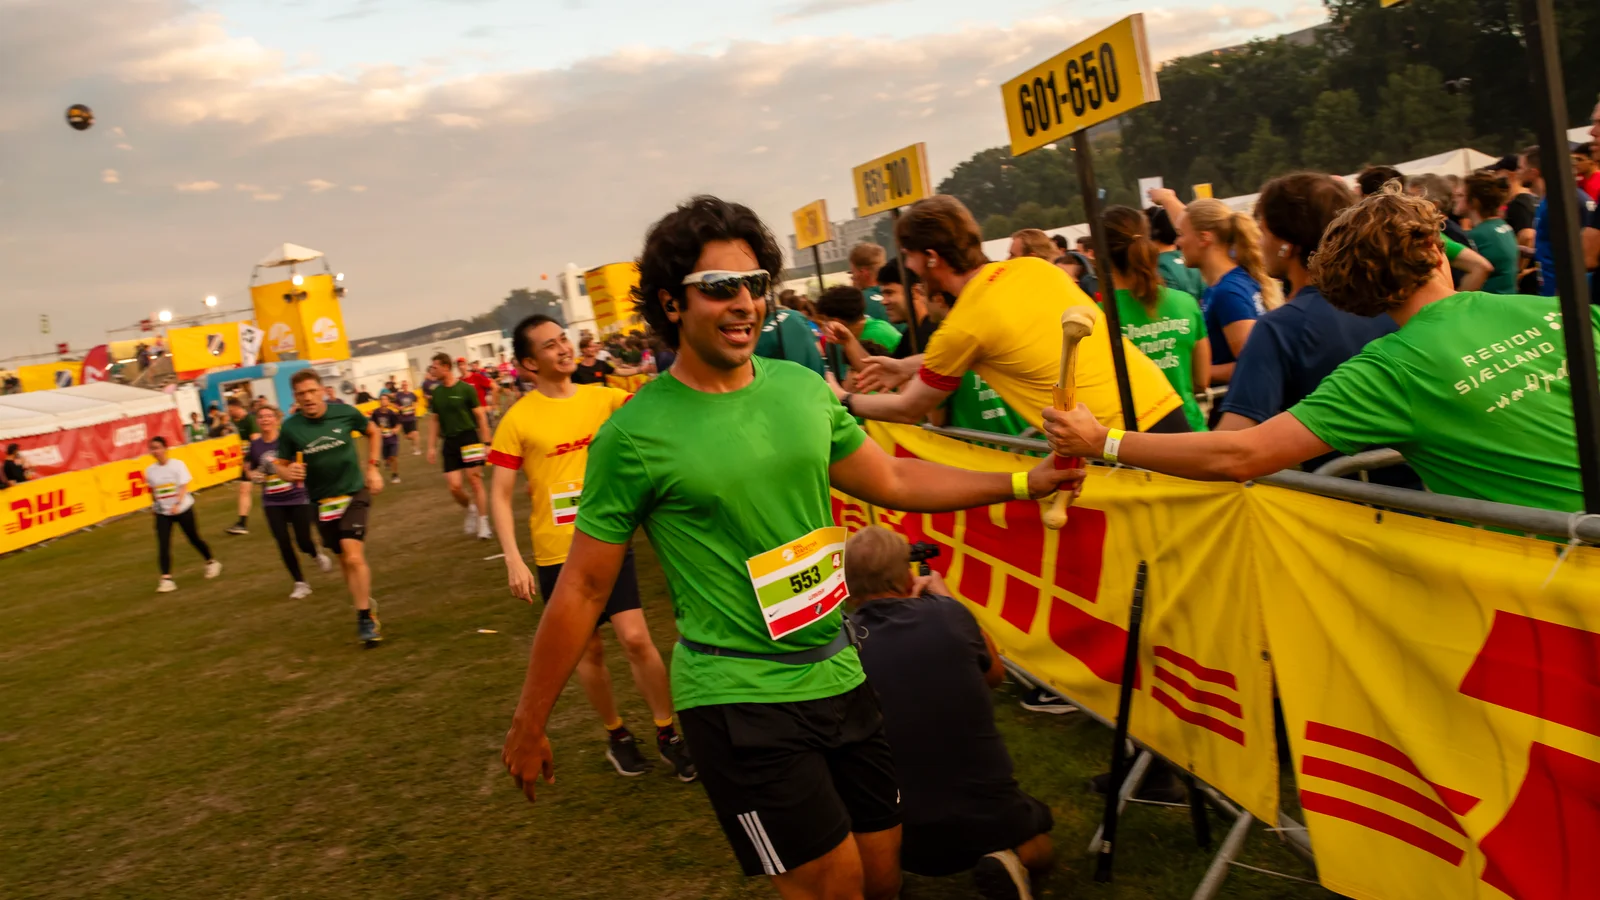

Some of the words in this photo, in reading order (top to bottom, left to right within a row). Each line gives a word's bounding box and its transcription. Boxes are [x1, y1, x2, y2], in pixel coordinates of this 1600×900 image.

[1018, 42, 1119, 137] 601-650
[862, 156, 912, 207] 651-700
[1454, 342, 1555, 395] SJÆLLAND
[1461, 327, 1542, 368] REGION
[8, 489, 74, 531] DHL
[789, 565, 822, 593] 553
[833, 553, 841, 568] 4
